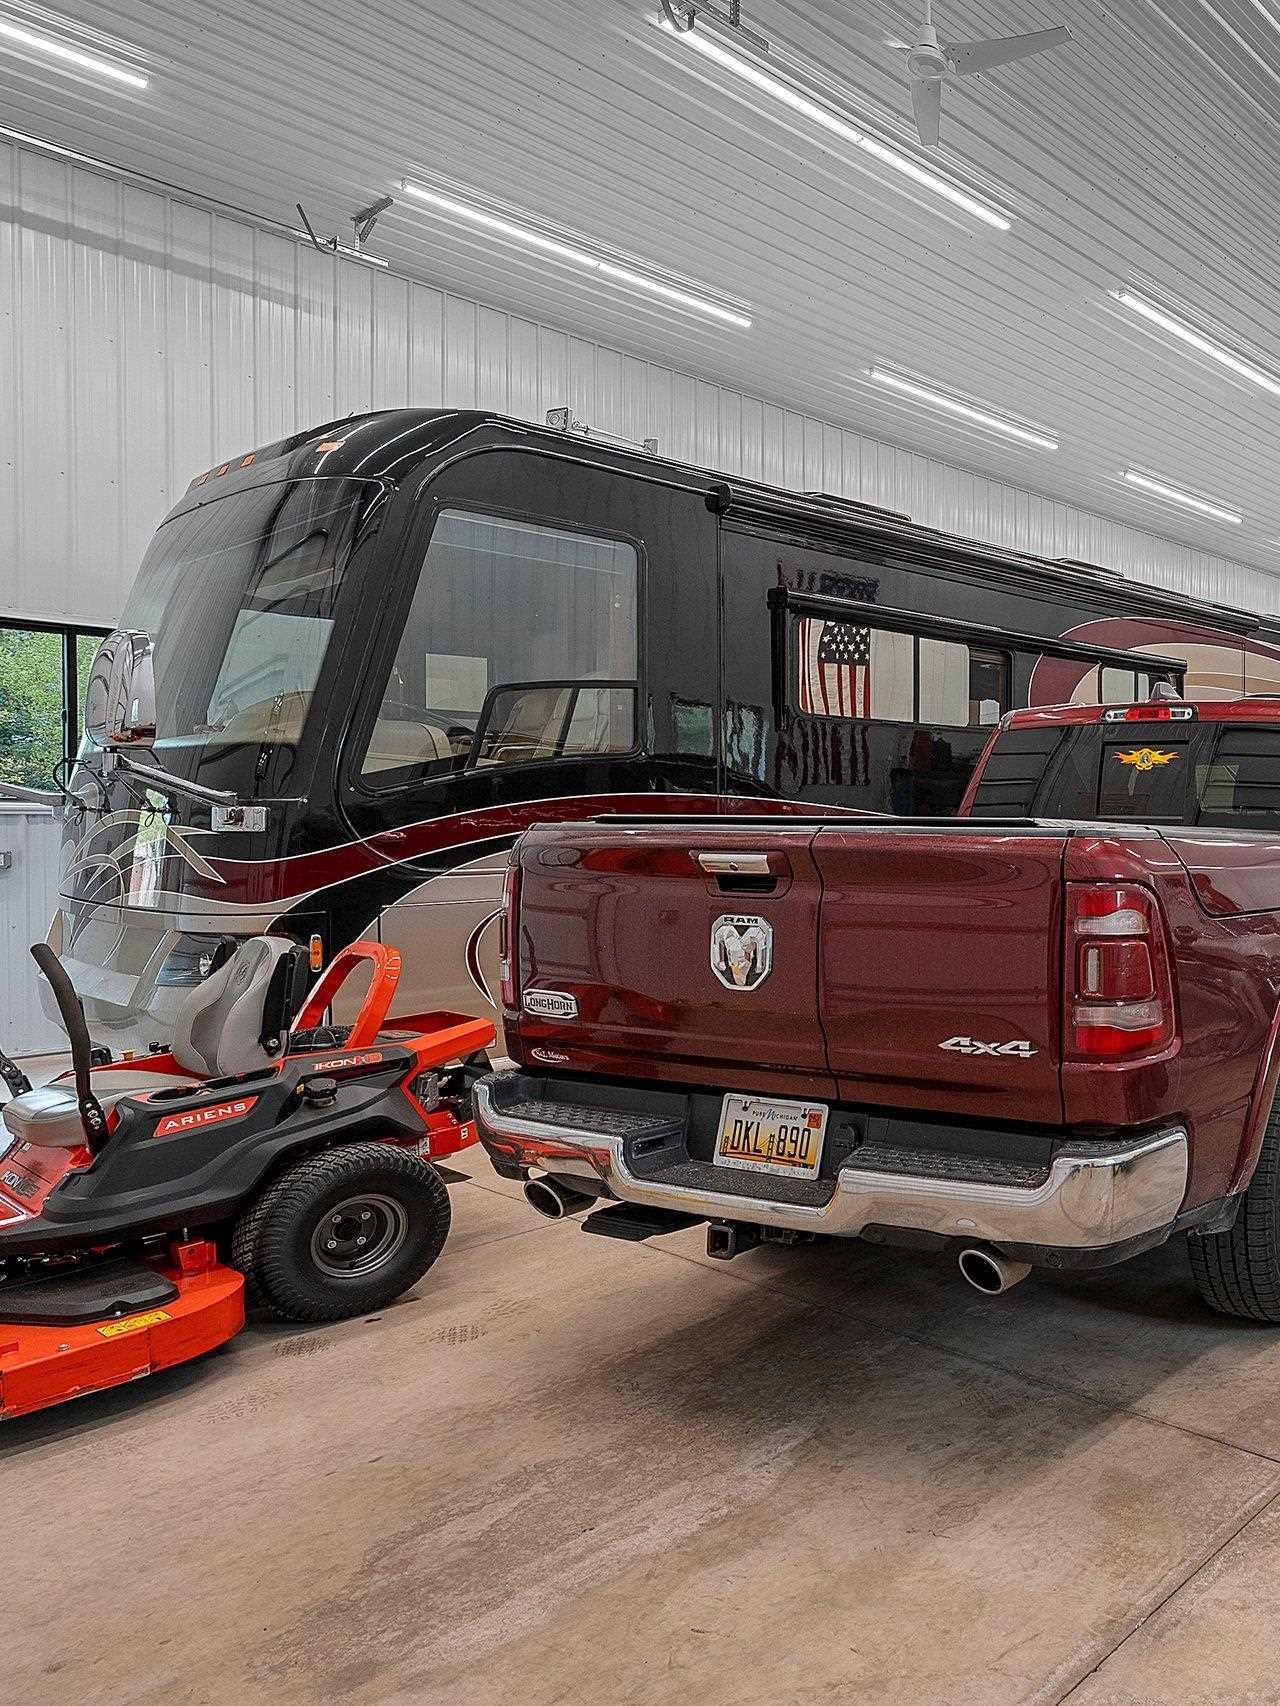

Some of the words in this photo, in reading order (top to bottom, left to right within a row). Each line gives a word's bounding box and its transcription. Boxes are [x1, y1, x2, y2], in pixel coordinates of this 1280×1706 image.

[723, 916, 759, 924] RAM
[524, 995, 574, 1012] LONGHORN
[165, 1102, 247, 1131] ARIENS
[729, 1118, 762, 1153] DKL
[775, 1124, 812, 1160] 890
